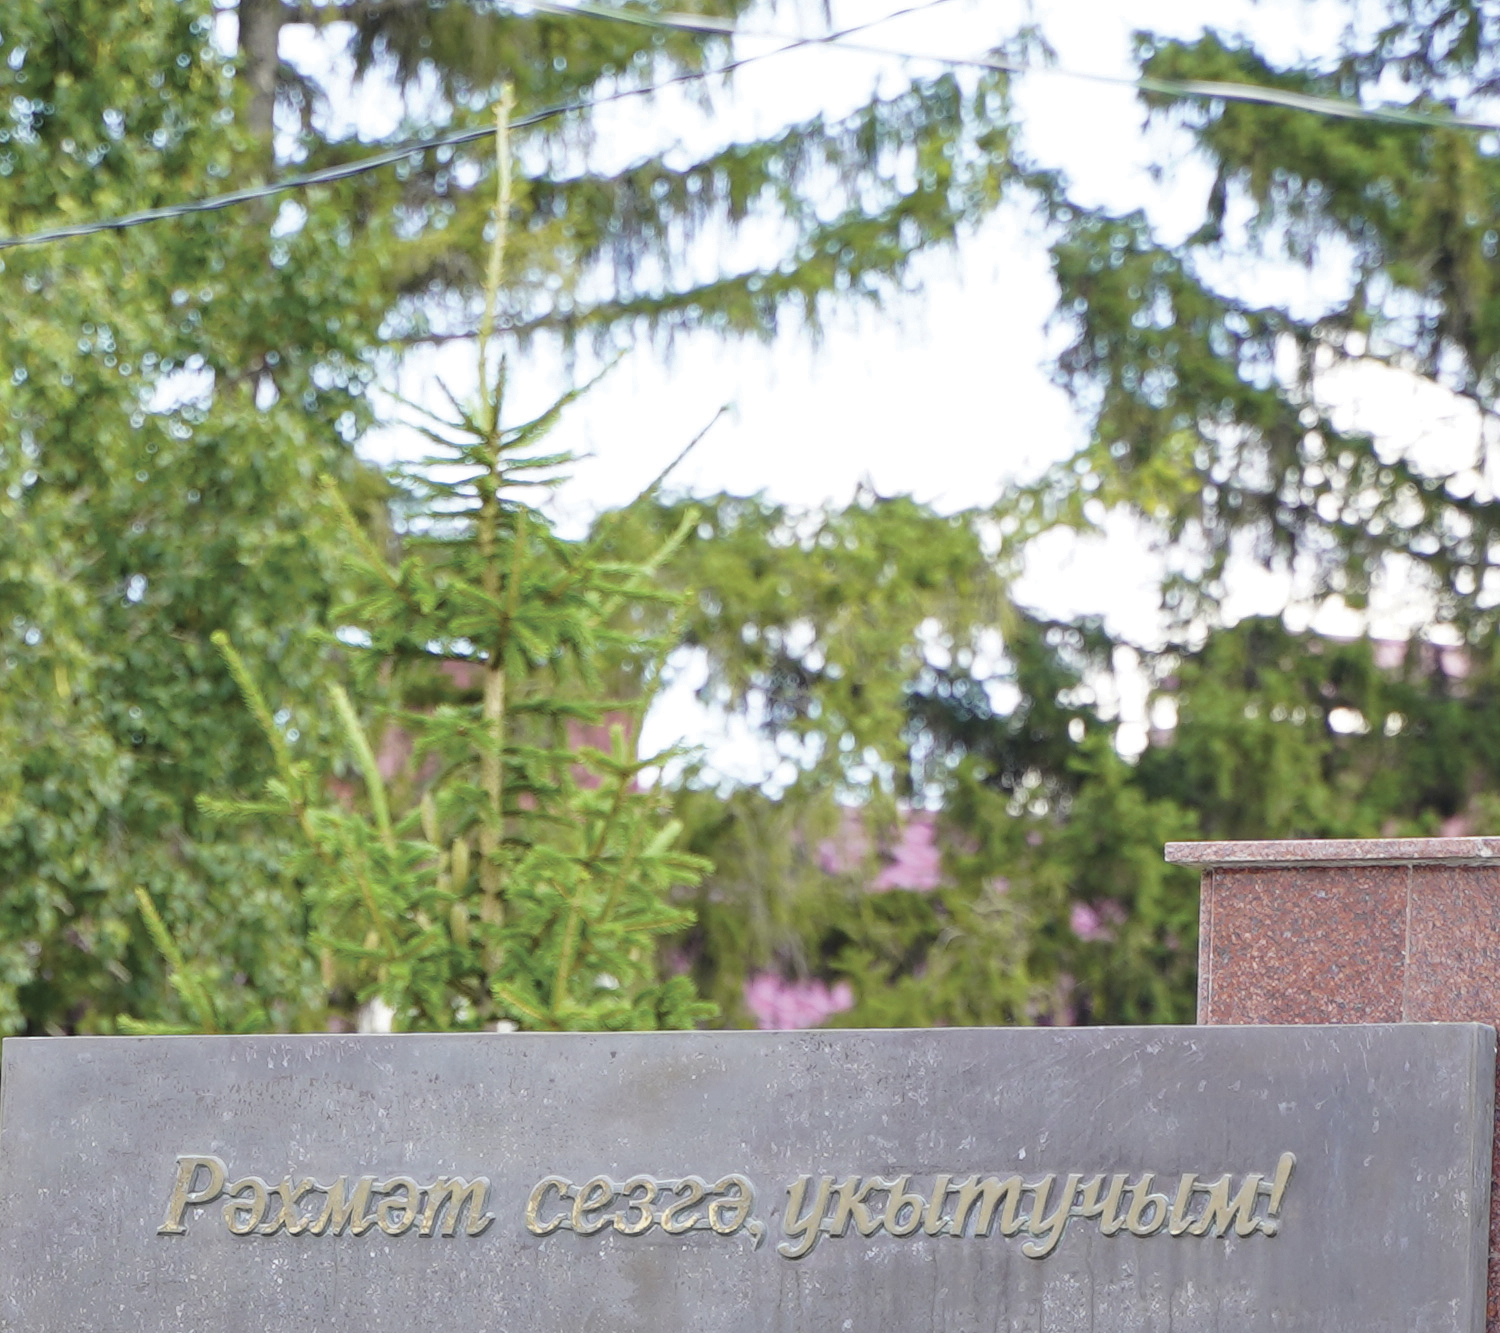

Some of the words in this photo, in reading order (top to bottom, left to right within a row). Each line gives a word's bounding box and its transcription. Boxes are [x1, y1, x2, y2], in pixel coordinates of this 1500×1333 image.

[155, 1154, 496, 1238] Рәхмәт
[524, 1173, 766, 1252] сезгә,
[776, 1151, 1297, 1259] укытучым!
